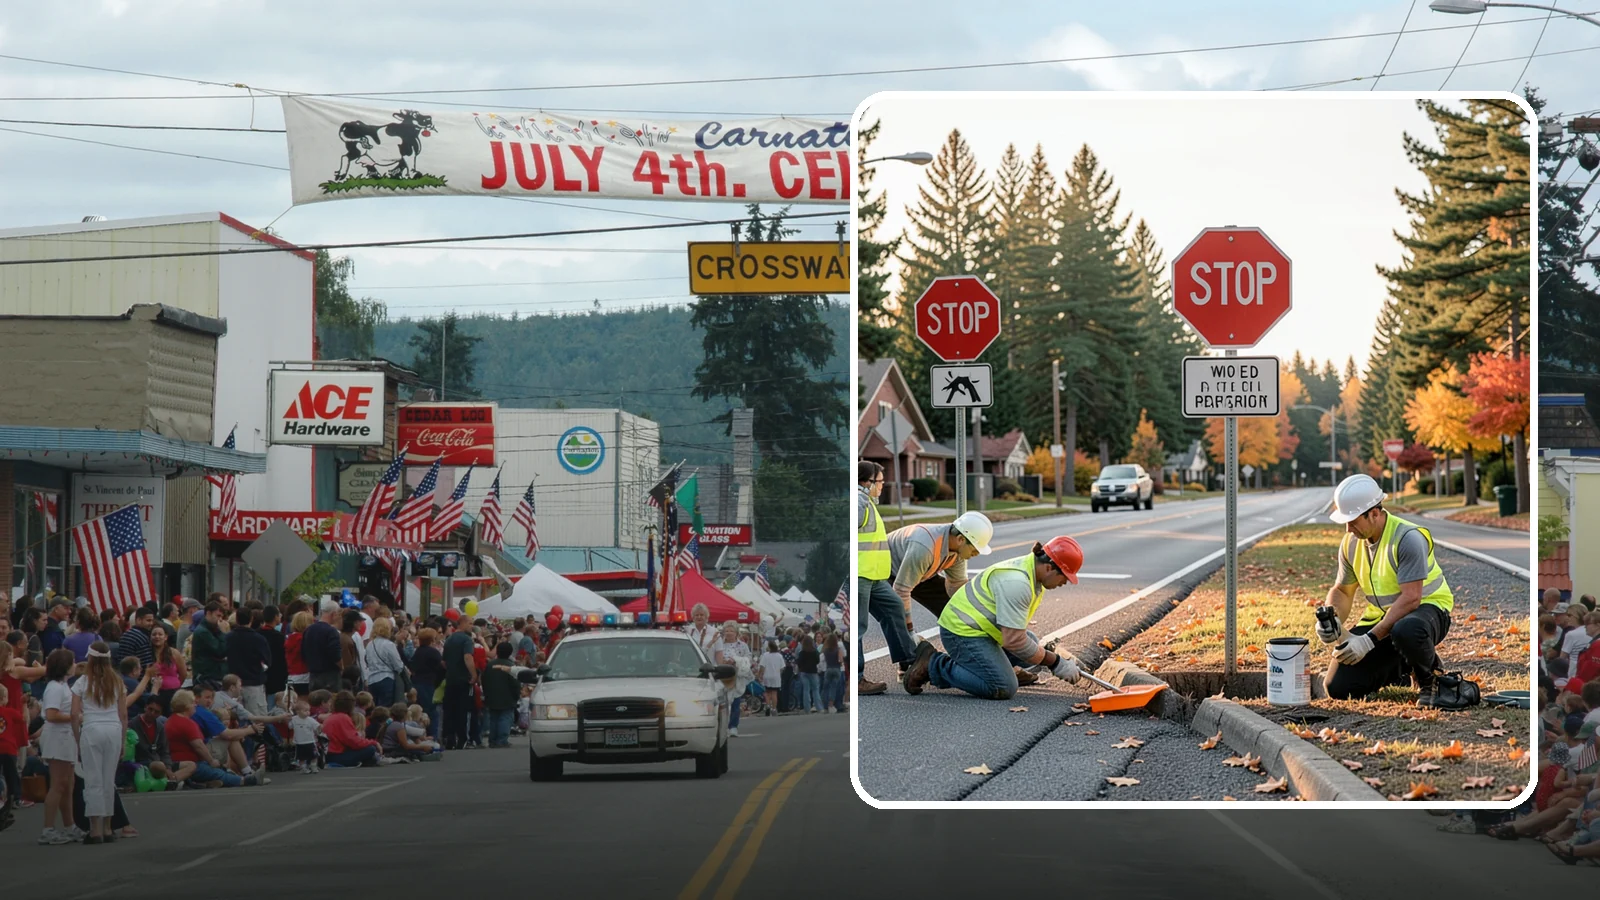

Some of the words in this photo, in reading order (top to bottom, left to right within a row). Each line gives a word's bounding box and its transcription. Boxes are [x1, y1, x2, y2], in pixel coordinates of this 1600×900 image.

[481, 141, 605, 193] JULY
[632, 150, 746, 198] 4th.
[697, 254, 850, 280] CROSSWA
[1188, 261, 1277, 306] STOP
[927, 301, 990, 336] STOP
[283, 380, 373, 420] ACE
[406, 410, 452, 422] CEDAR
[284, 421, 371, 437] Hardware
[354, 467, 384, 479] Simpl
[95, 485, 124, 495] Vincent
[126, 486, 135, 495] de
[137, 486, 155, 495] Paul
[80, 502, 154, 522] THT
[688, 526, 741, 535] CRNATION
[699, 535, 730, 544] GLASS
